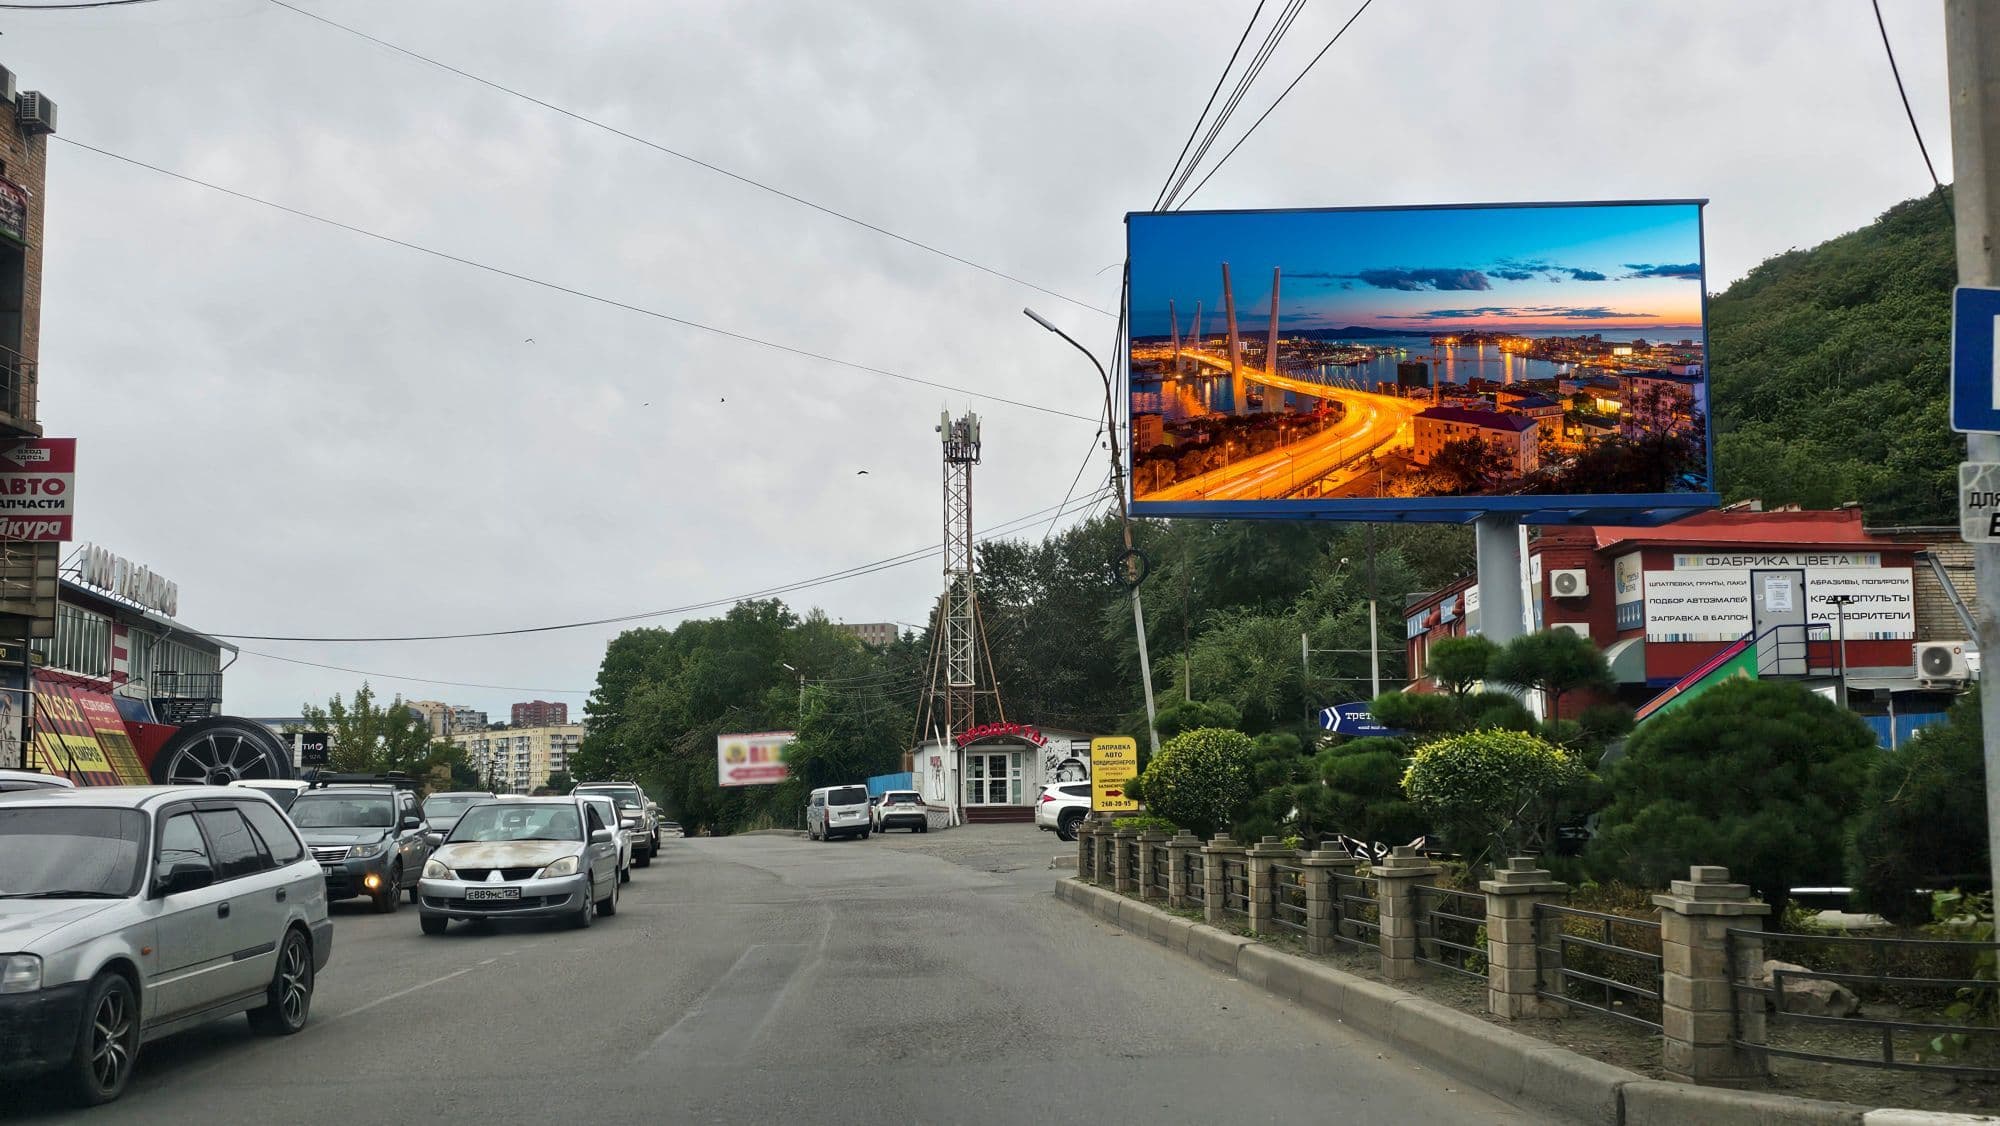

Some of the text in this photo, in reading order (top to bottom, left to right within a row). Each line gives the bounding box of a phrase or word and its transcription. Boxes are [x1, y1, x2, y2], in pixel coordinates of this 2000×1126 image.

[0, 478, 66, 495] АВТО
[1705, 555, 1850, 567] ФАБРИКА ЦВЕТА
[1687, 596, 1748, 604] АВТОЭМАЛЕЙ
[1811, 612, 1911, 620] РАСТВОРИТЕЛИ
[956, 722, 1048, 748] ПРОДУКТЫ
